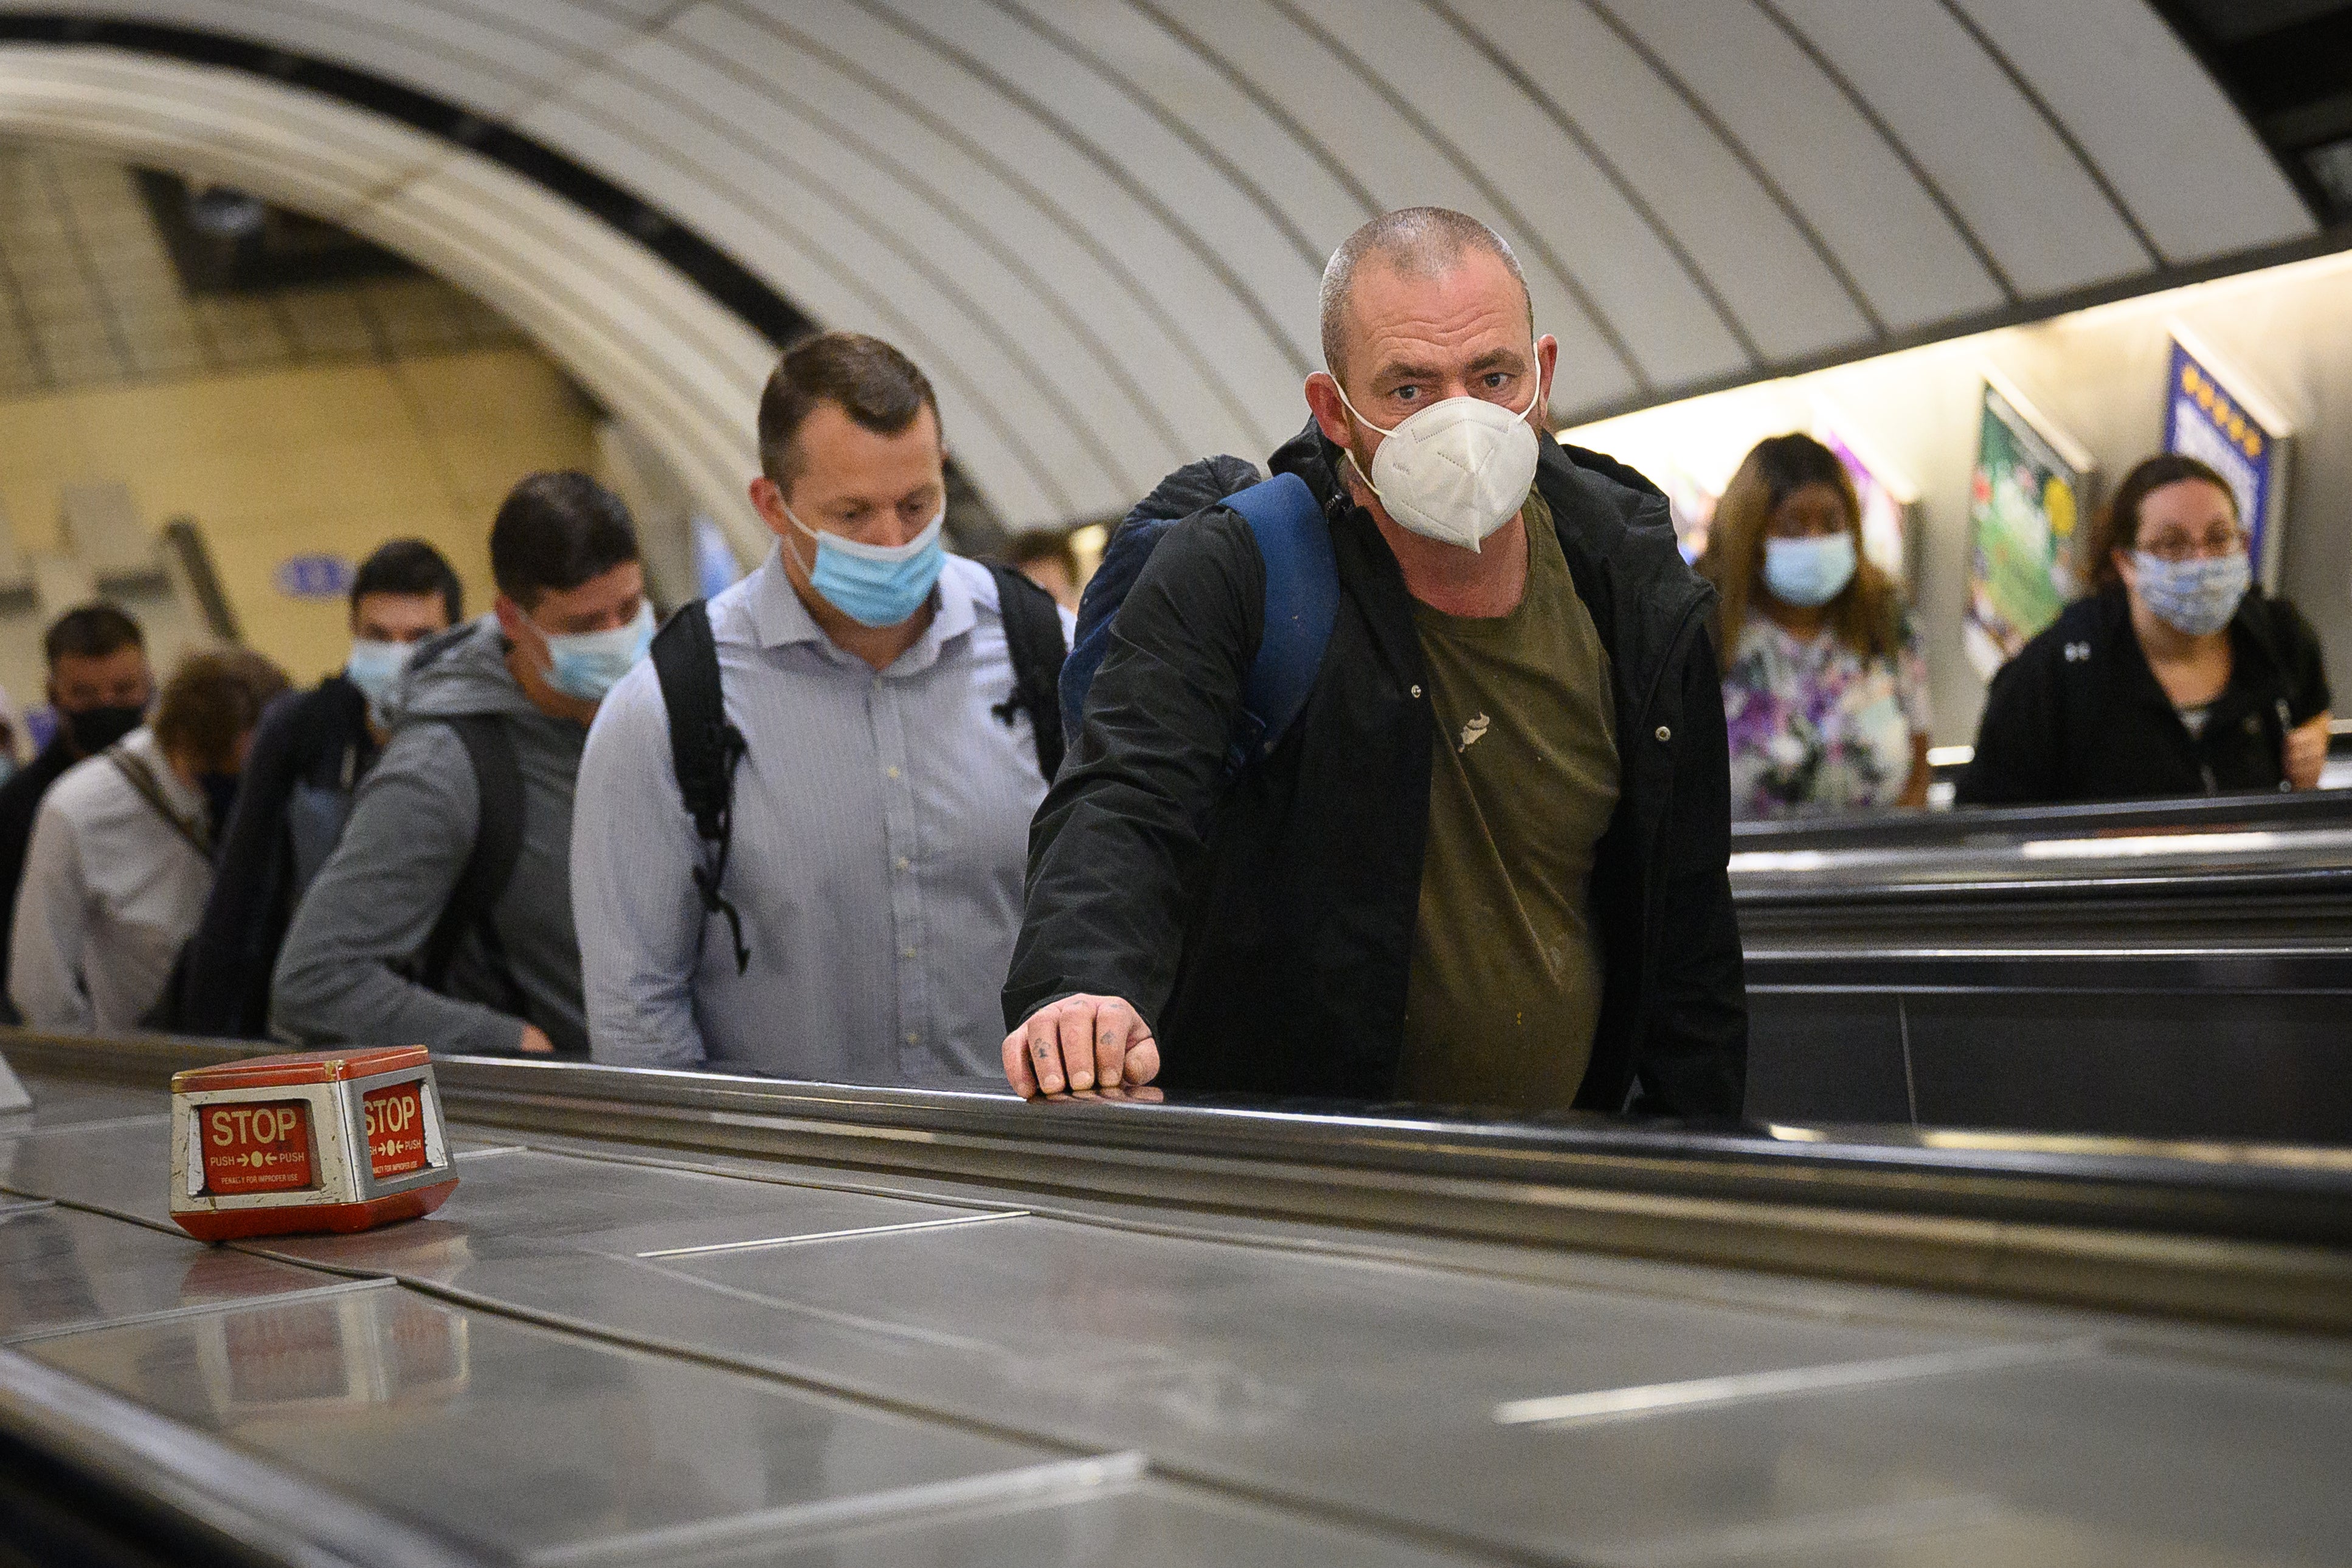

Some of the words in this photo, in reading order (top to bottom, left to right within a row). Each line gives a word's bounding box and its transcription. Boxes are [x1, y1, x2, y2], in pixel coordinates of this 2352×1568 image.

[364, 1096, 415, 1136] STOP
[212, 1108, 297, 1146] STOP
[405, 1139, 421, 1150] PUSH
[210, 1156, 235, 1166] PUSH
[279, 1152, 304, 1162] PUSH
[246, 1175, 257, 1184] FOR
[258, 1173, 286, 1183] IMPROPER
